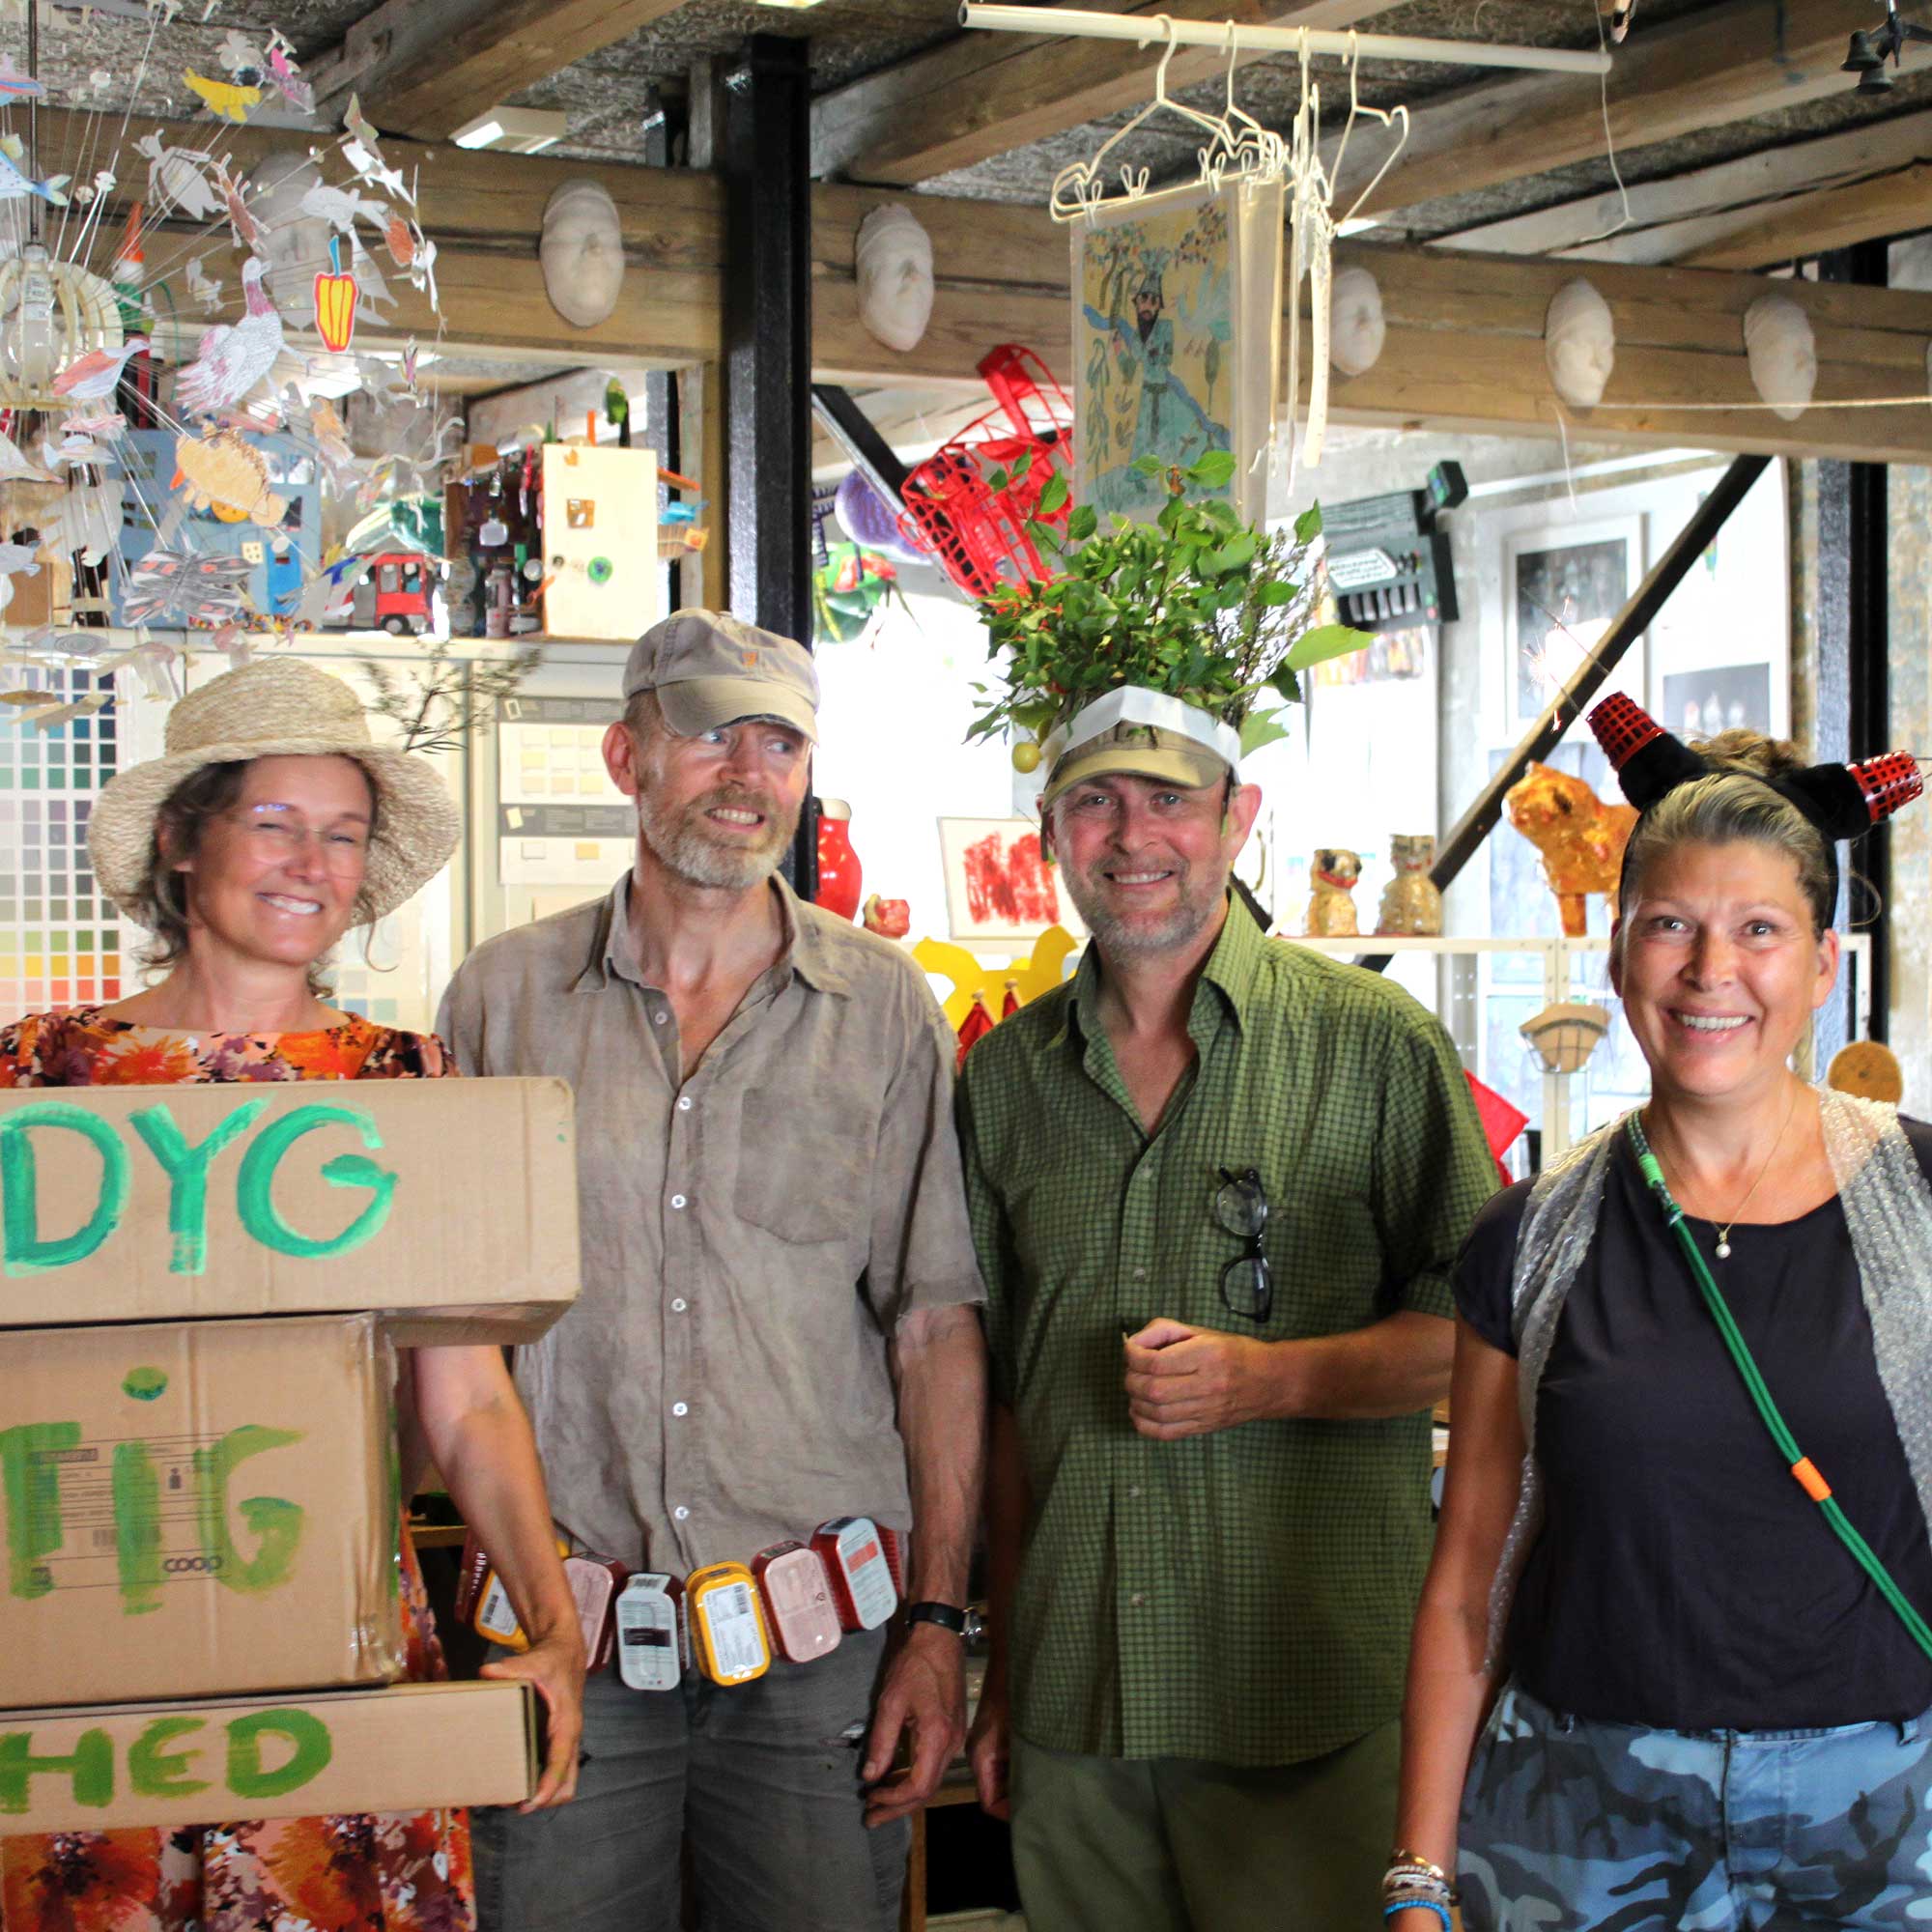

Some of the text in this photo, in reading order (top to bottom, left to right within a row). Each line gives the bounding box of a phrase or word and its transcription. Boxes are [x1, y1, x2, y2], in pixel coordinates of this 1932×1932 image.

[0, 1093, 399, 1277] DYG
[164, 1556, 222, 1573] coop
[0, 1709, 332, 1814] HED
